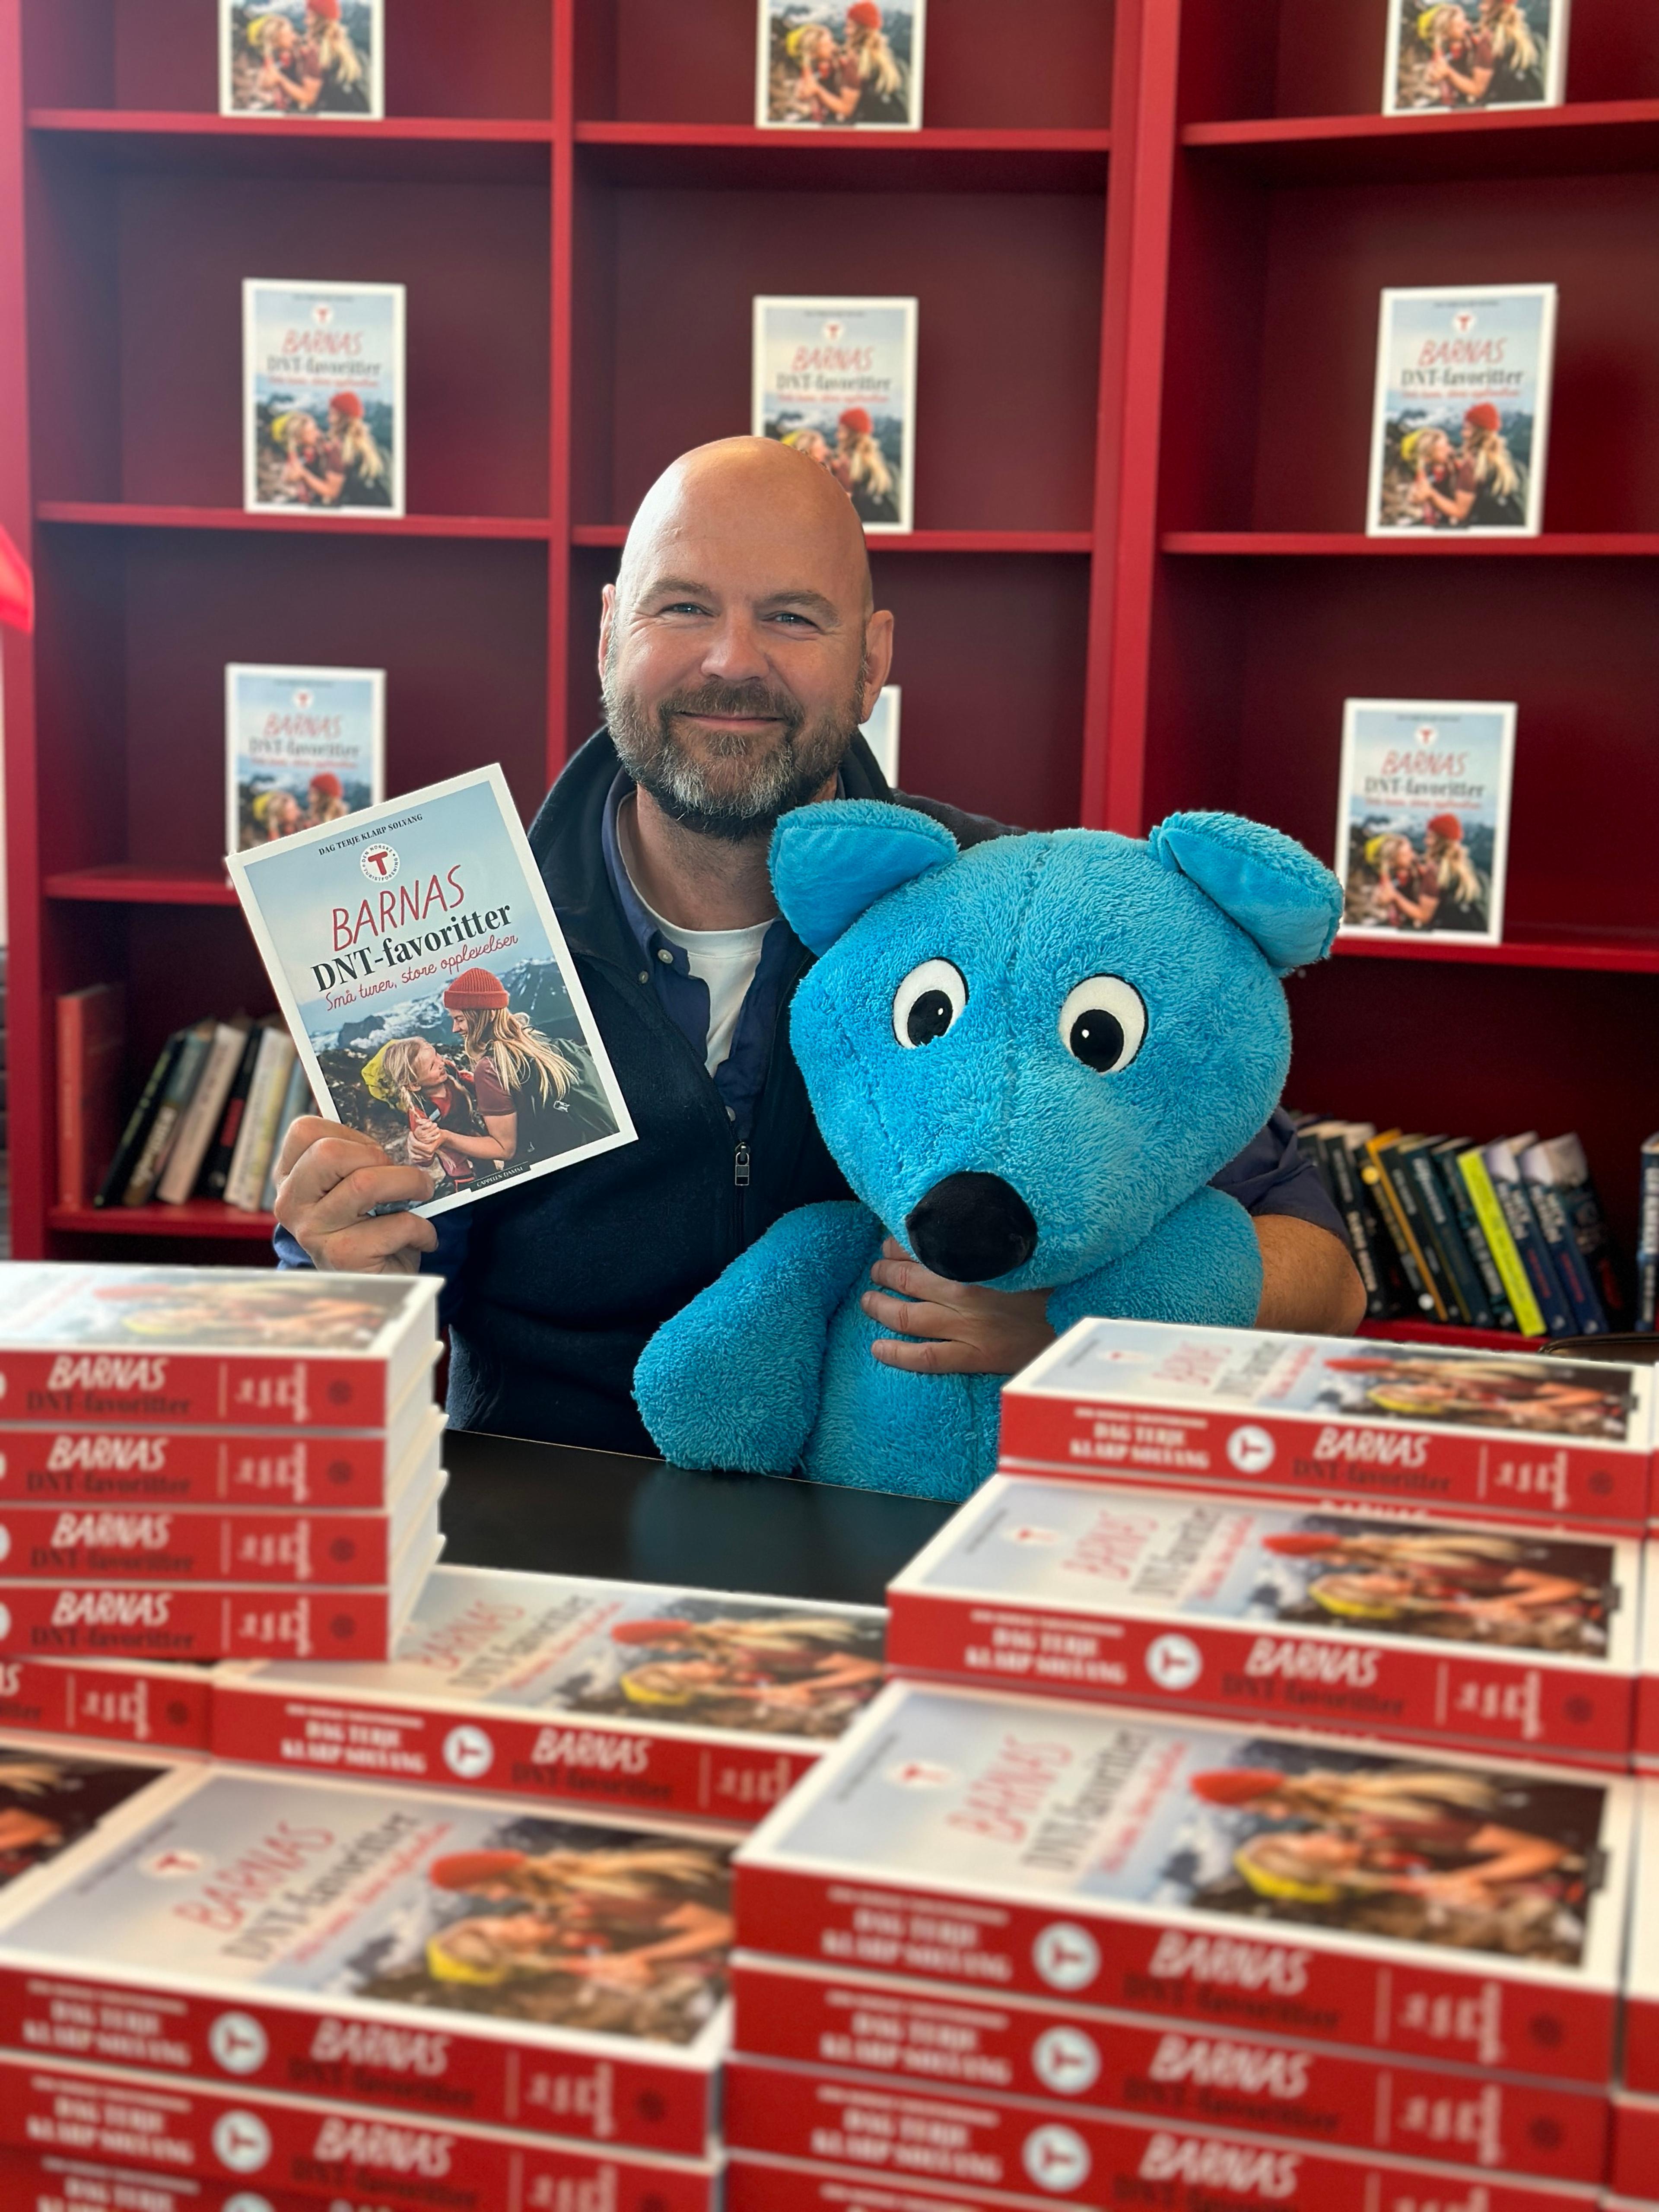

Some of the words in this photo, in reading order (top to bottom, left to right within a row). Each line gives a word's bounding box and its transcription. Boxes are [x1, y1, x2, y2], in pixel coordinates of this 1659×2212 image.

[1418, 337, 1508, 366] BARNAS
[1381, 749, 1469, 776] BARNAS
[318, 844, 335, 855] DAG
[336, 836, 360, 849] TERJE
[361, 826, 386, 840] KLARP
[388, 814, 423, 831] SOLVANG
[368, 851, 388, 875] T
[333, 864, 464, 951] BARNAS
[311, 905, 511, 992] DNT-favoritter
[326, 990, 356, 1011] Små
[359, 979, 397, 998] turer,
[402, 964, 437, 984] store
[441, 934, 518, 975] opplevelser
[503, 1166, 524, 1177] DAMM
[47, 1354, 169, 1391] BARNAS
[47, 1435, 169, 1471] BARNAS
[1313, 1426, 1431, 1468] BARNAS
[51, 1512, 172, 1549] BARNAS
[51, 1590, 172, 1628] BARNAS
[1246, 1637, 1380, 1687] BARNAS
[531, 1728, 653, 1774] BARNAS
[1147, 1929, 1313, 1996] BARNAS
[310, 2016, 453, 2077] BARNAS
[1147, 2033, 1313, 2099] BARNAS
[313, 2116, 457, 2178] BARNAS
